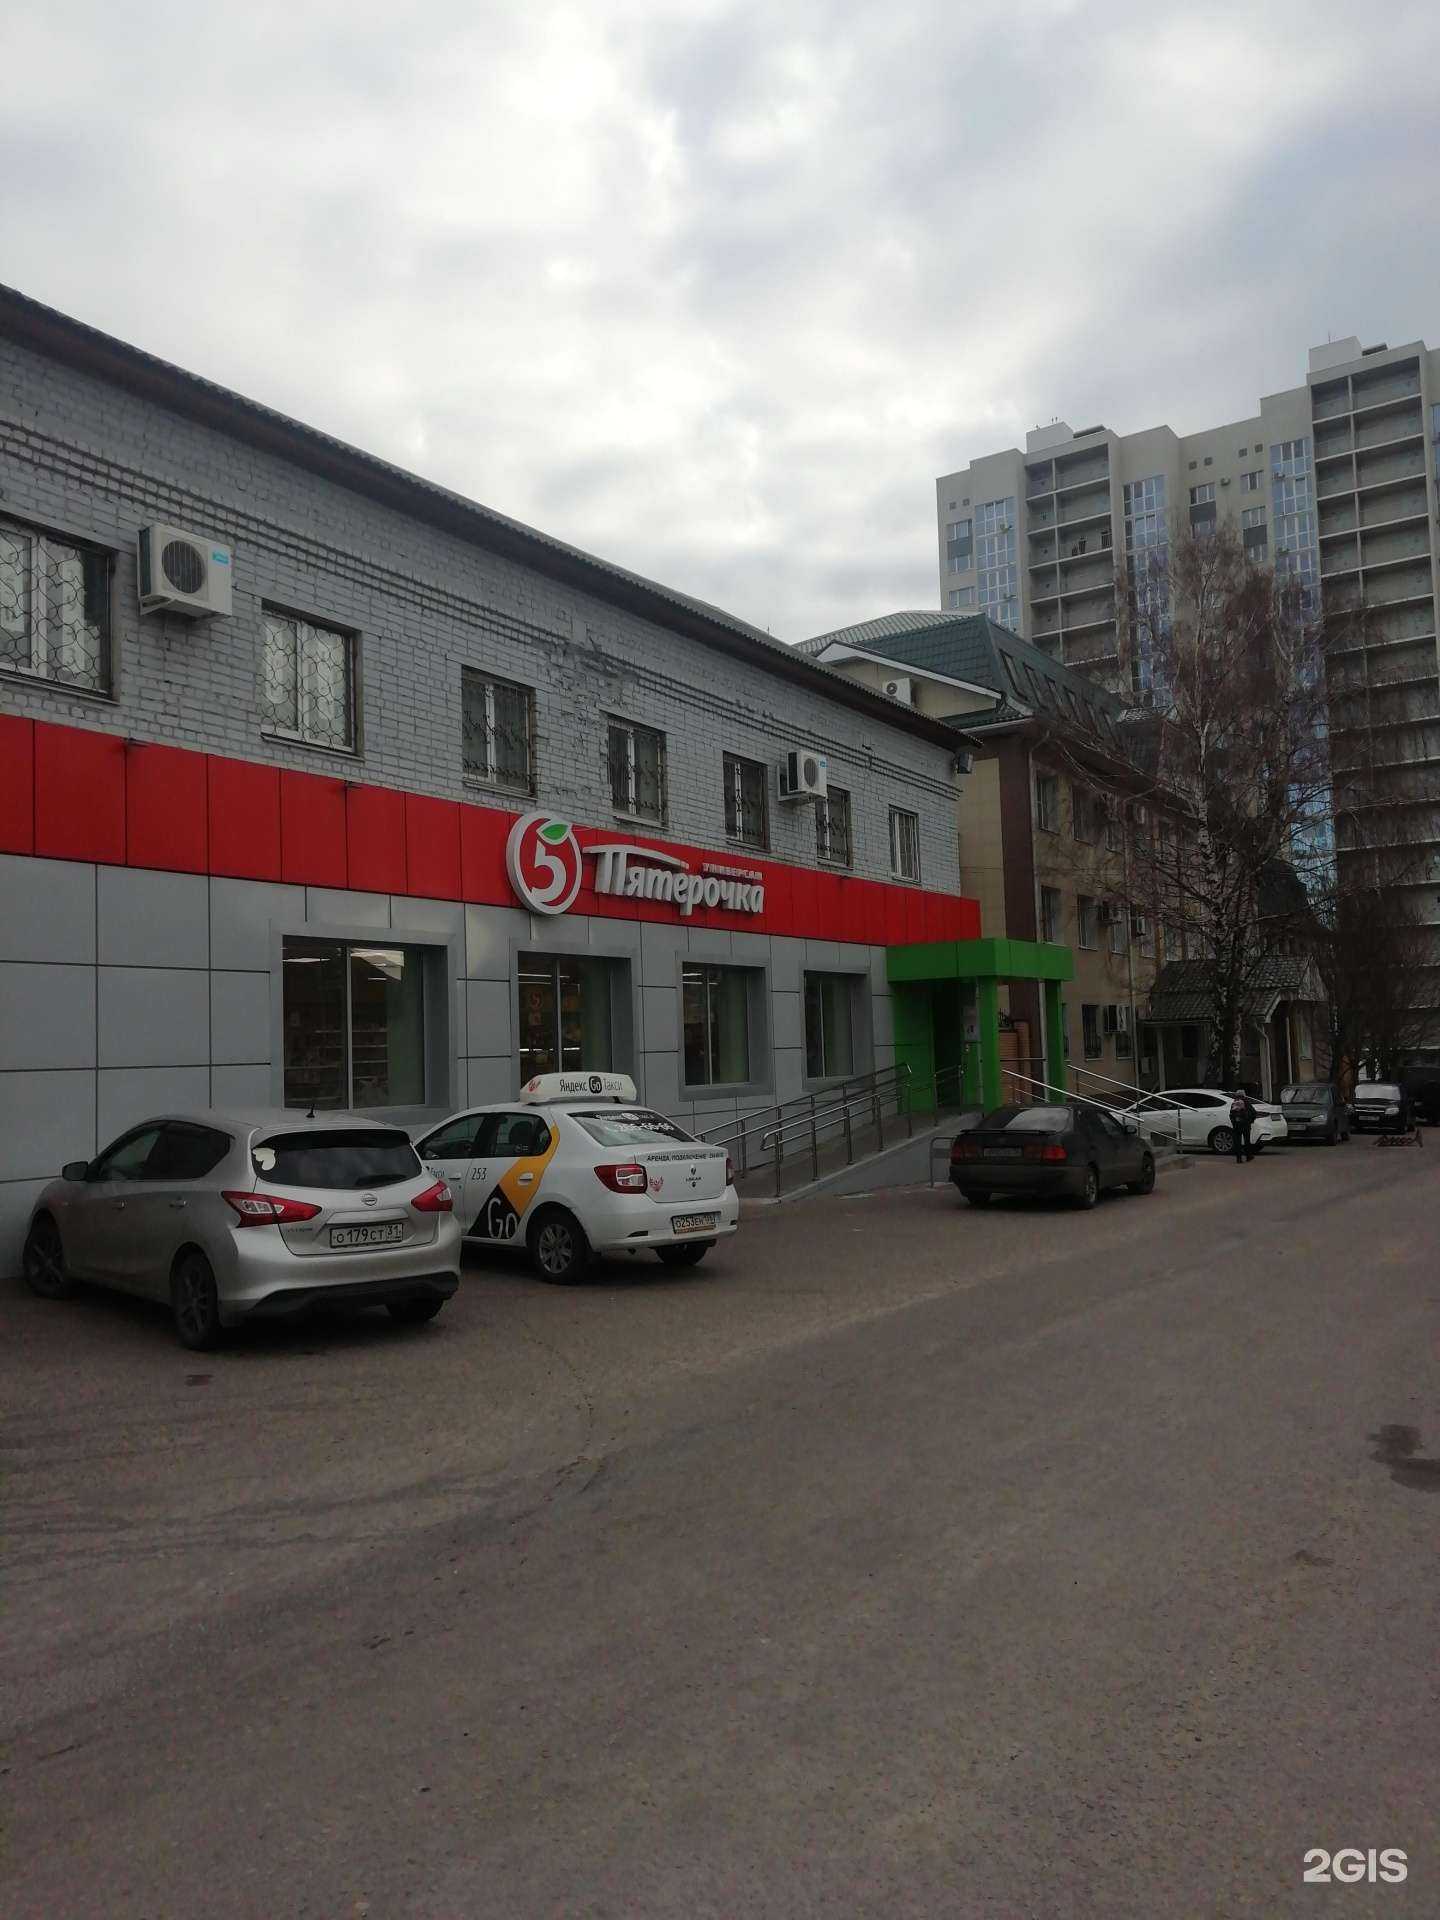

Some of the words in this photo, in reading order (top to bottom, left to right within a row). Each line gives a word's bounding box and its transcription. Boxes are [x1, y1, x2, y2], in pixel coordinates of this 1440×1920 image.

[582, 844, 765, 916] Пятерочка
[559, 1079, 587, 1093] Яндекс
[590, 1077, 602, 1093] Go
[603, 1078, 623, 1092] Такси
[471, 1167, 487, 1180] 253
[487, 1197, 518, 1240] Go
